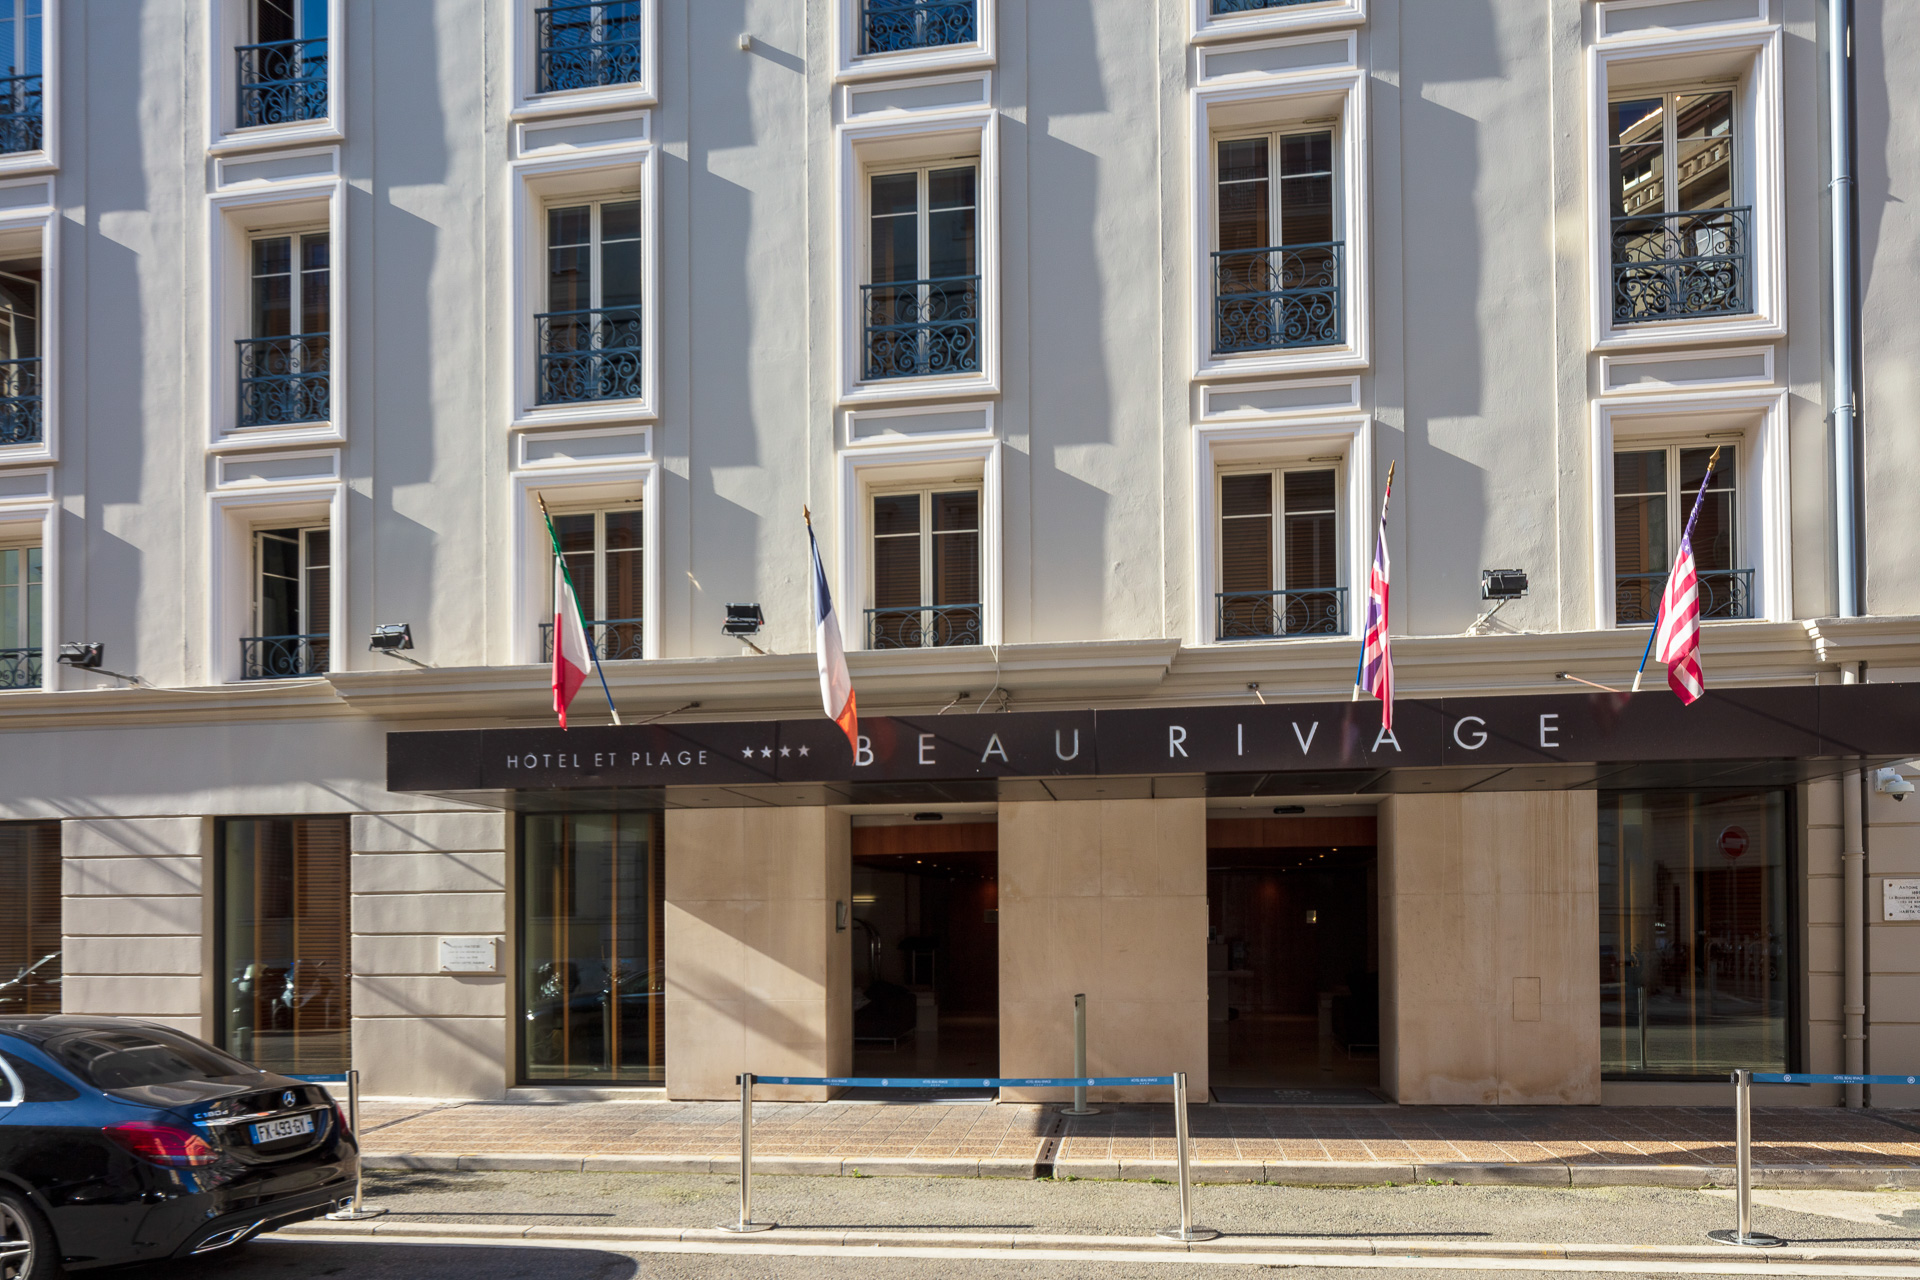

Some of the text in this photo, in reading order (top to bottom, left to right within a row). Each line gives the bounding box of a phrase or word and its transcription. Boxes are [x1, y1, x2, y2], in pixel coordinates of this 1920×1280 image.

[855, 713, 1560, 767] BEAU RIVAGE
[507, 750, 708, 769] HÔTEL ET PLAGE
[258, 1117, 306, 1141] FX-493-GY
